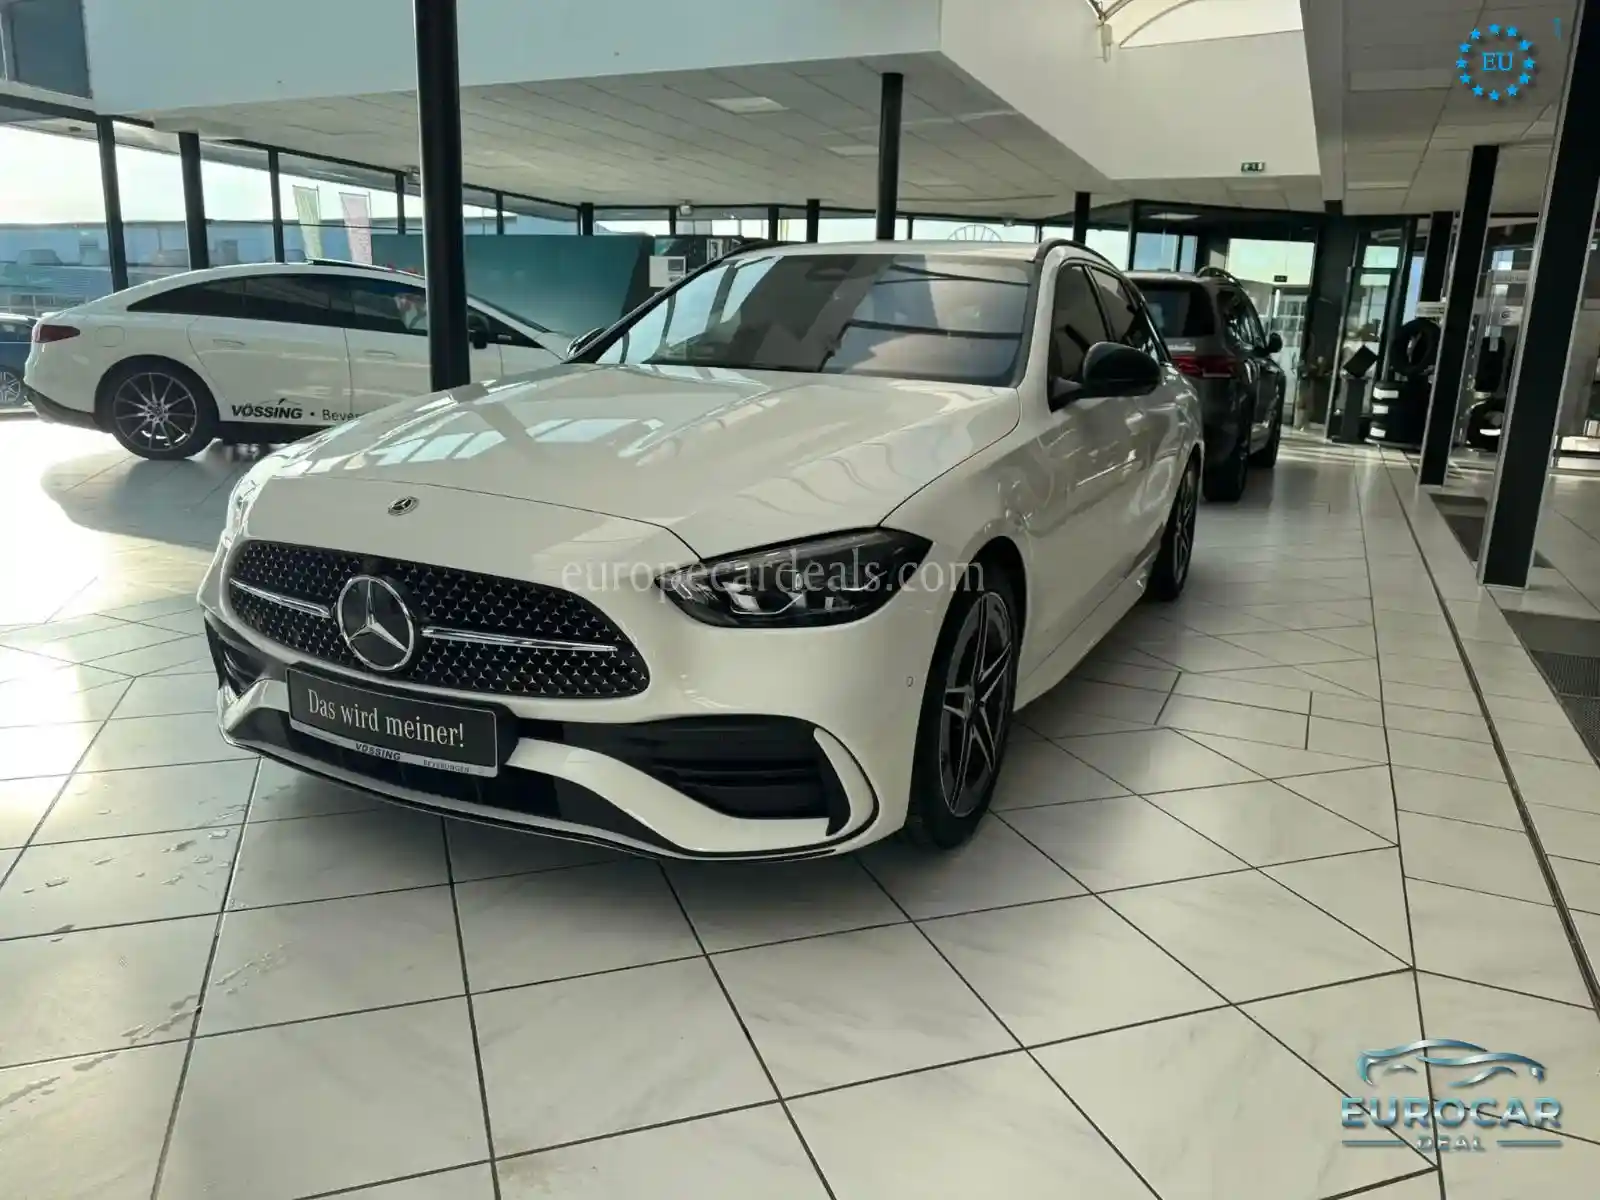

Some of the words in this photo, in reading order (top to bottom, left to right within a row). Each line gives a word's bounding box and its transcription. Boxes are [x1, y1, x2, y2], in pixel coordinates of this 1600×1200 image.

[231, 403, 303, 419] VÖSSING
[307, 688, 336, 720] Das
[340, 703, 380, 732] wird
[385, 715, 465, 748] meiner!
